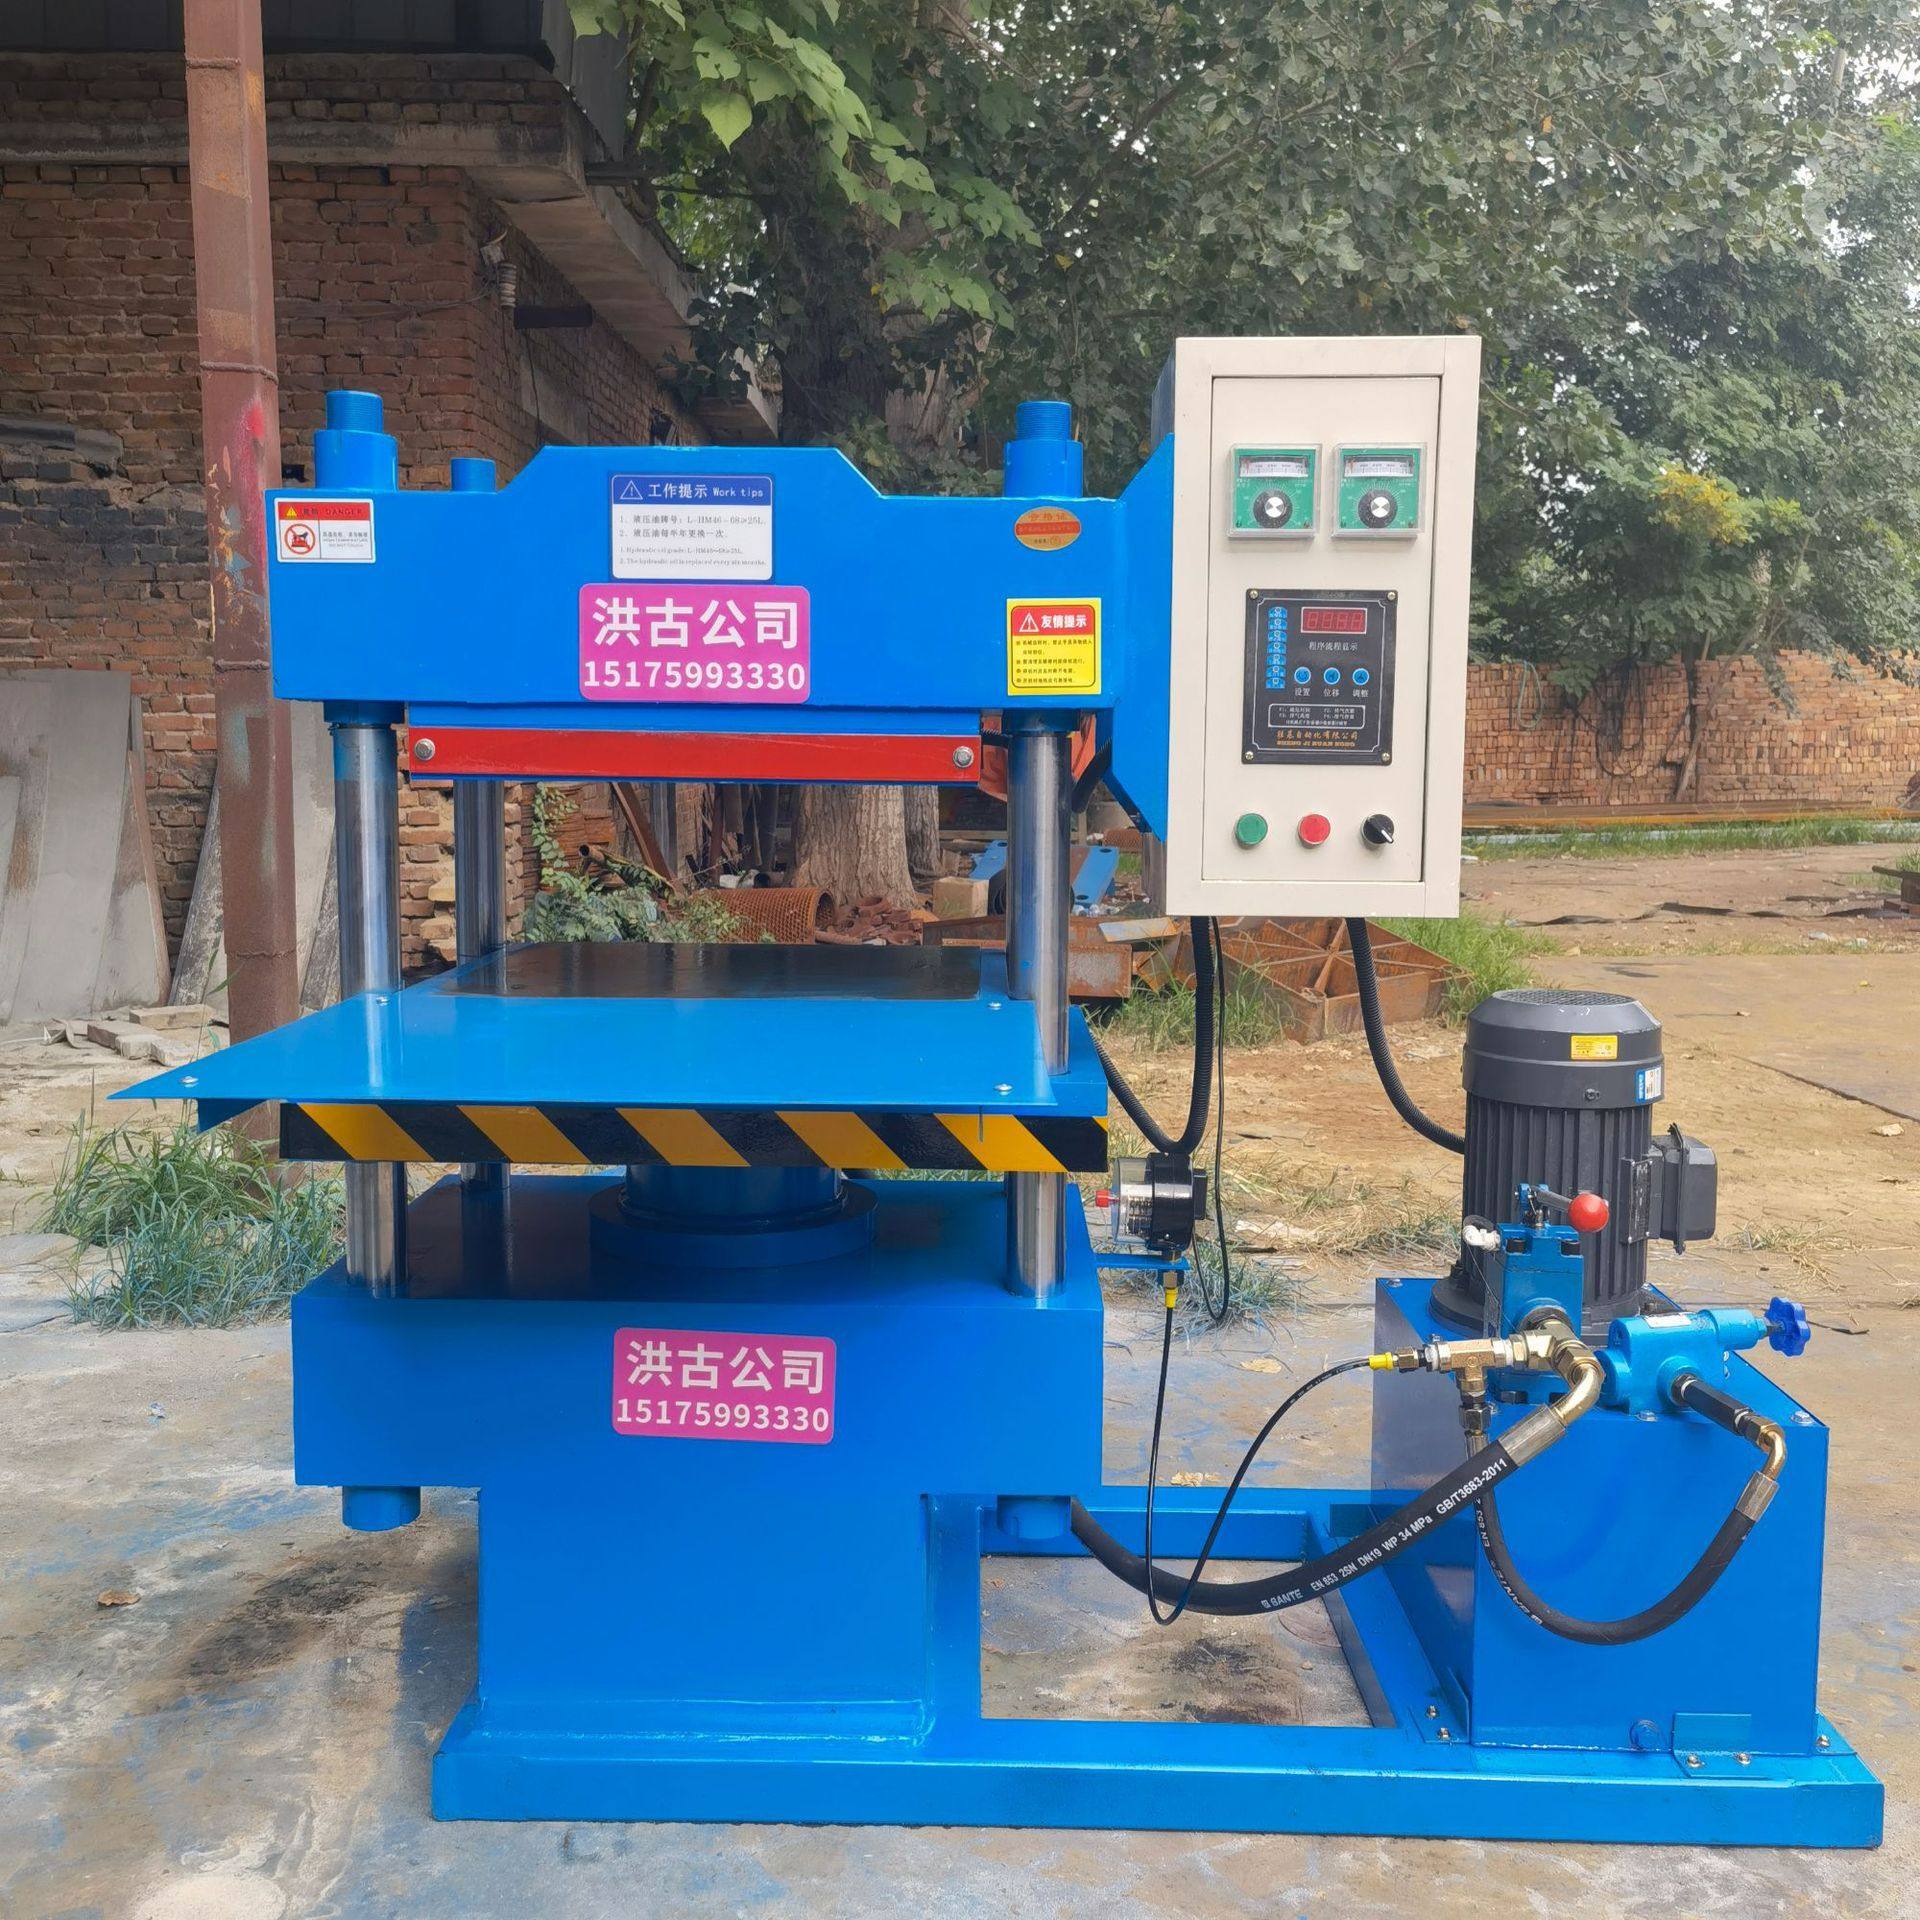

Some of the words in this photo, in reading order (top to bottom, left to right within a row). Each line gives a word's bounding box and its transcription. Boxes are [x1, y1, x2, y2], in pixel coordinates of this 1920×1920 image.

[648, 483, 708, 499] 工作提示
[713, 487, 736, 497] Work
[741, 487, 764, 499] tips
[325, 508, 362, 516] DANGER
[592, 597, 798, 650] 洪古公司
[1041, 614, 1088, 629] 友情提示
[583, 660, 807, 691] 15175993330
[1294, 687, 1311, 697] 设置
[1323, 688, 1340, 698] 位移
[1352, 688, 1369, 698] 调整
[626, 1340, 825, 1395] 洪古公司
[616, 1398, 830, 1433] 15175993330
[1310, 1581, 1325, 1592] EN
[1322, 1572, 1339, 1586] 853
[1338, 1562, 1358, 1578] 2SN
[1357, 1548, 1383, 1567] DN19
[1381, 1536, 1399, 1552] WP
[1398, 1528, 1413, 1542] 34
[1409, 1515, 1434, 1534] MPa
[1435, 1457, 1509, 1515] GB/T3683-2011
